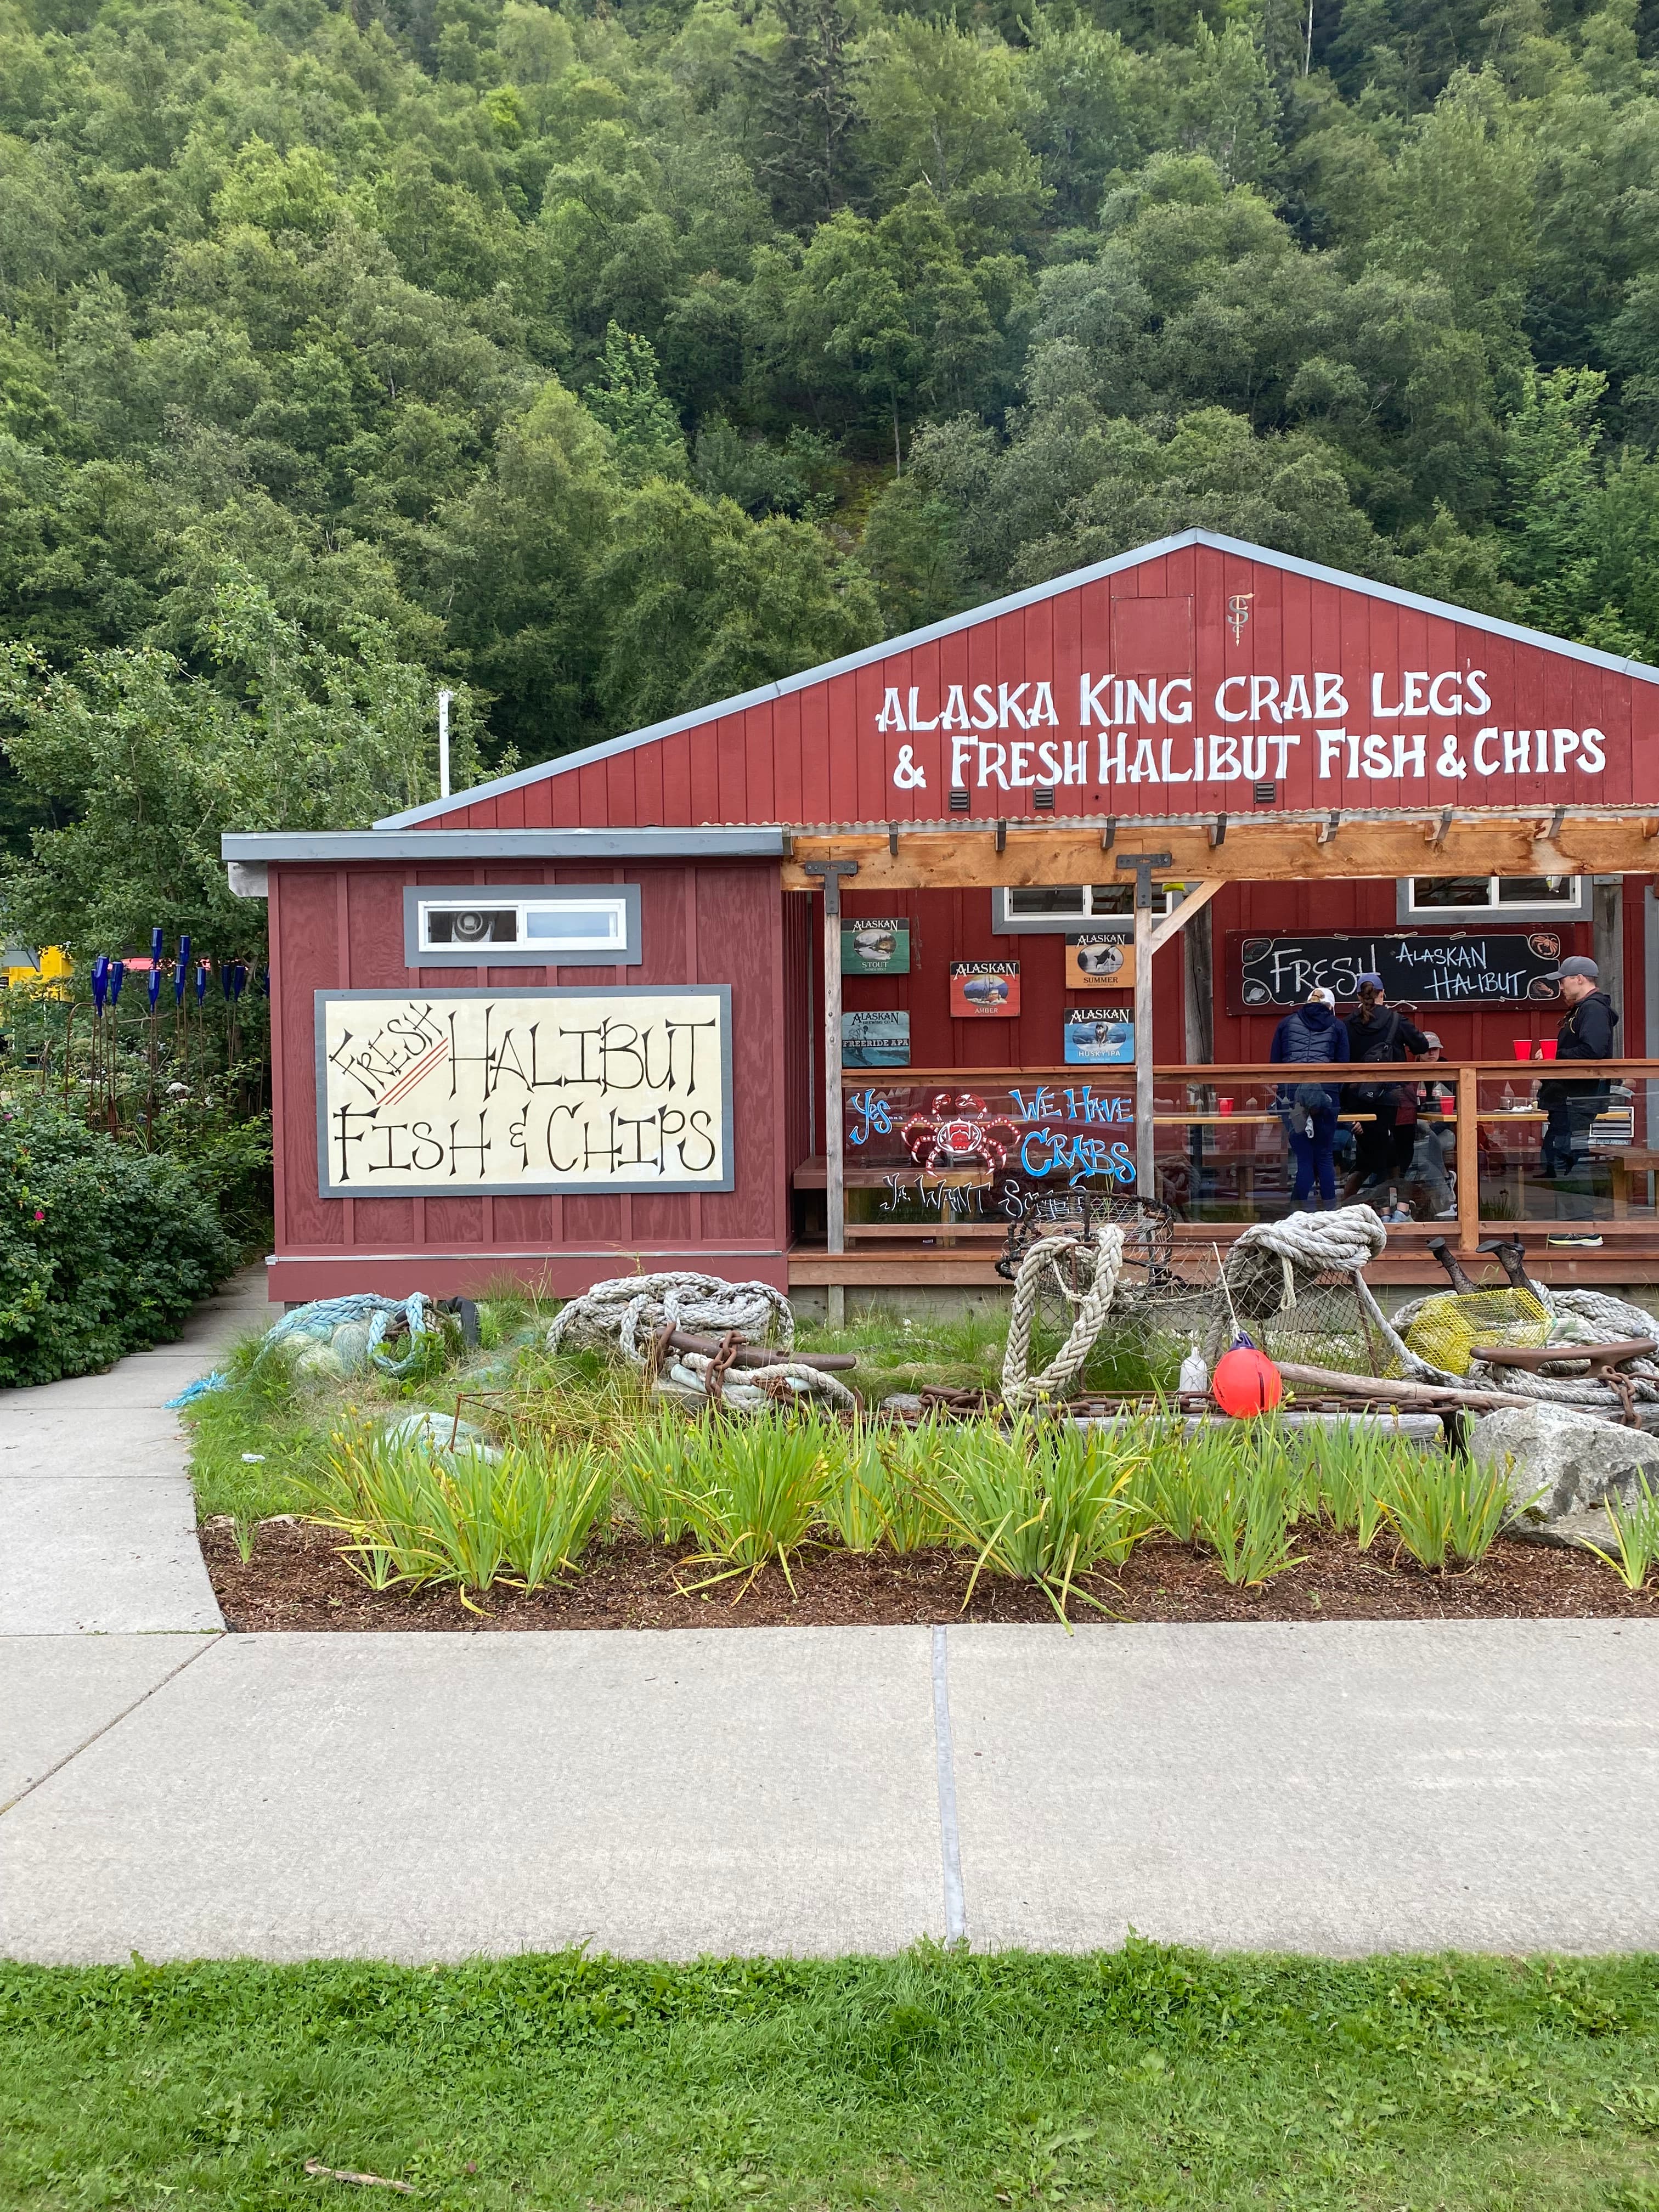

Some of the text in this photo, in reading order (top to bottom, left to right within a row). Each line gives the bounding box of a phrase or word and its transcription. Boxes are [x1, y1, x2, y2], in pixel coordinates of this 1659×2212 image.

[876, 670, 1492, 732] ALASKA KING CRAB LEGS
[893, 726, 1607, 791] & FRESH HALIBUT FISH & CHIPS
[851, 920, 899, 933] ALASKAN
[1075, 934, 1126, 949] ALASKAN
[953, 963, 1017, 981] ALASKAN
[1269, 941, 1487, 996] FRESH ALASKAN
[1424, 967, 1527, 1000] HALIBUT
[851, 1012, 899, 1026] ALASKAN
[1069, 1009, 1130, 1026] ALASKAN
[328, 1002, 716, 1103] FRESH HALIBUT
[332, 1099, 715, 1183] FISH & CHIPS
[1020, 1127, 1137, 1186] CRABS
